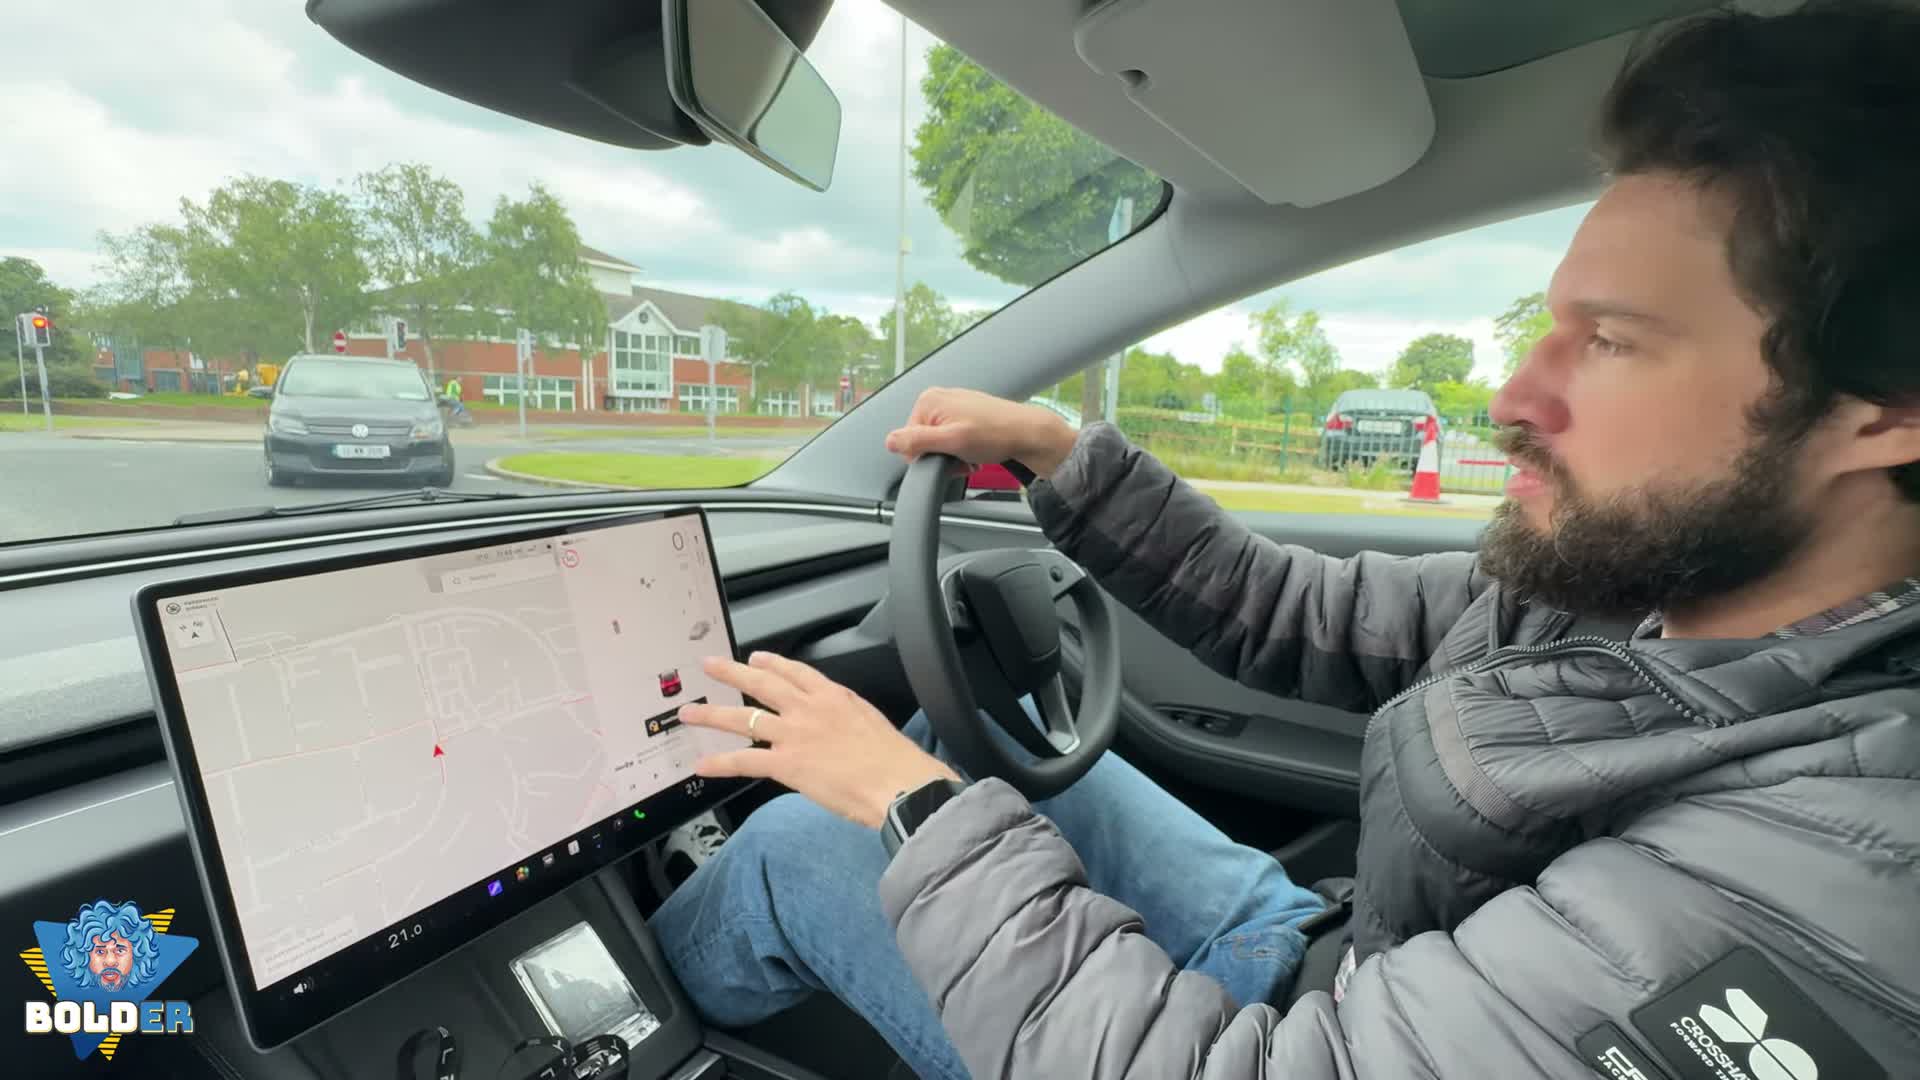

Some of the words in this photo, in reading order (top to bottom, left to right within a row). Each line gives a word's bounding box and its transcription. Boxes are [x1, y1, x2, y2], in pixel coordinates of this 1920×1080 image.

[388, 924, 422, 949] 21.0
[1670, 1022, 1715, 1067] FORWARD
[1681, 1017, 1751, 1080] CROSSHA
